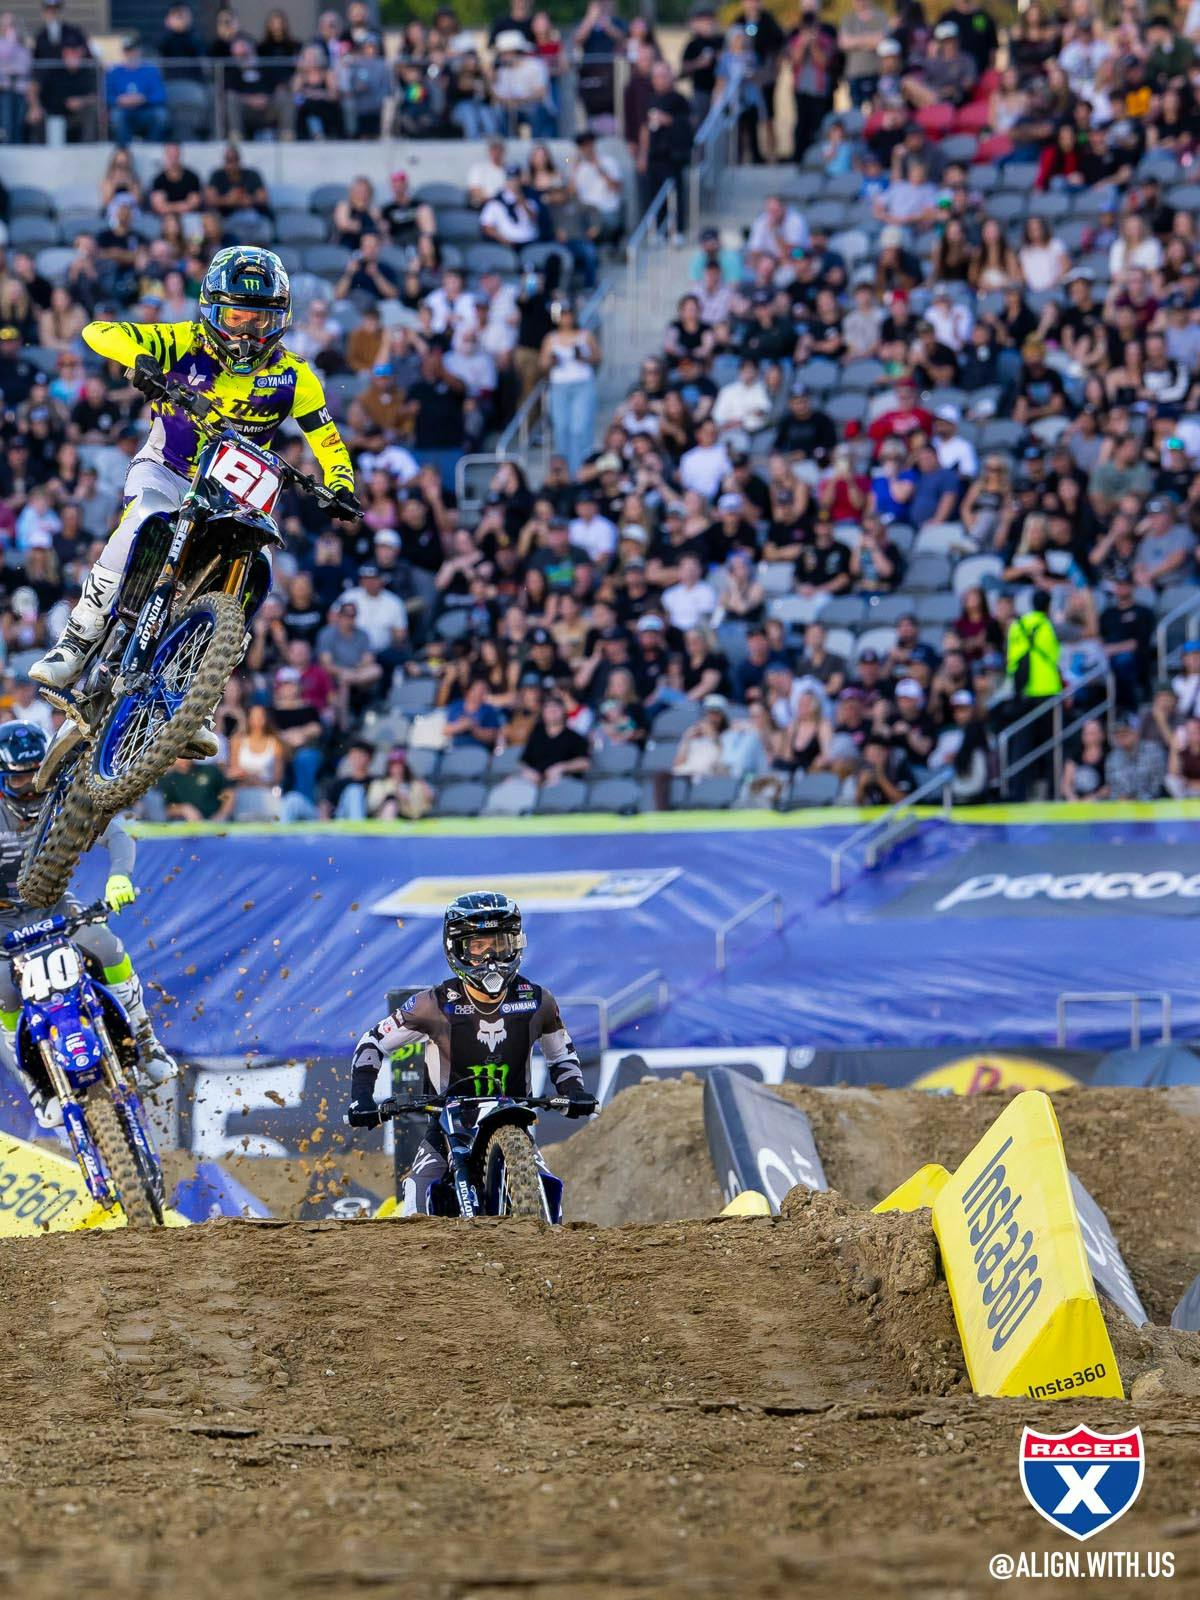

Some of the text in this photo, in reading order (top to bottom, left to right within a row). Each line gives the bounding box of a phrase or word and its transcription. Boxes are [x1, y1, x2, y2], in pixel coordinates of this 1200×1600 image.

[210, 444, 280, 511] 61
[139, 594, 164, 651] DUNLOP
[21, 946, 80, 1001] 40
[511, 1002, 537, 1012] YAMAHA
[961, 1135, 1043, 1352] Insta360
[1028, 1363, 1106, 1398] Insta360
